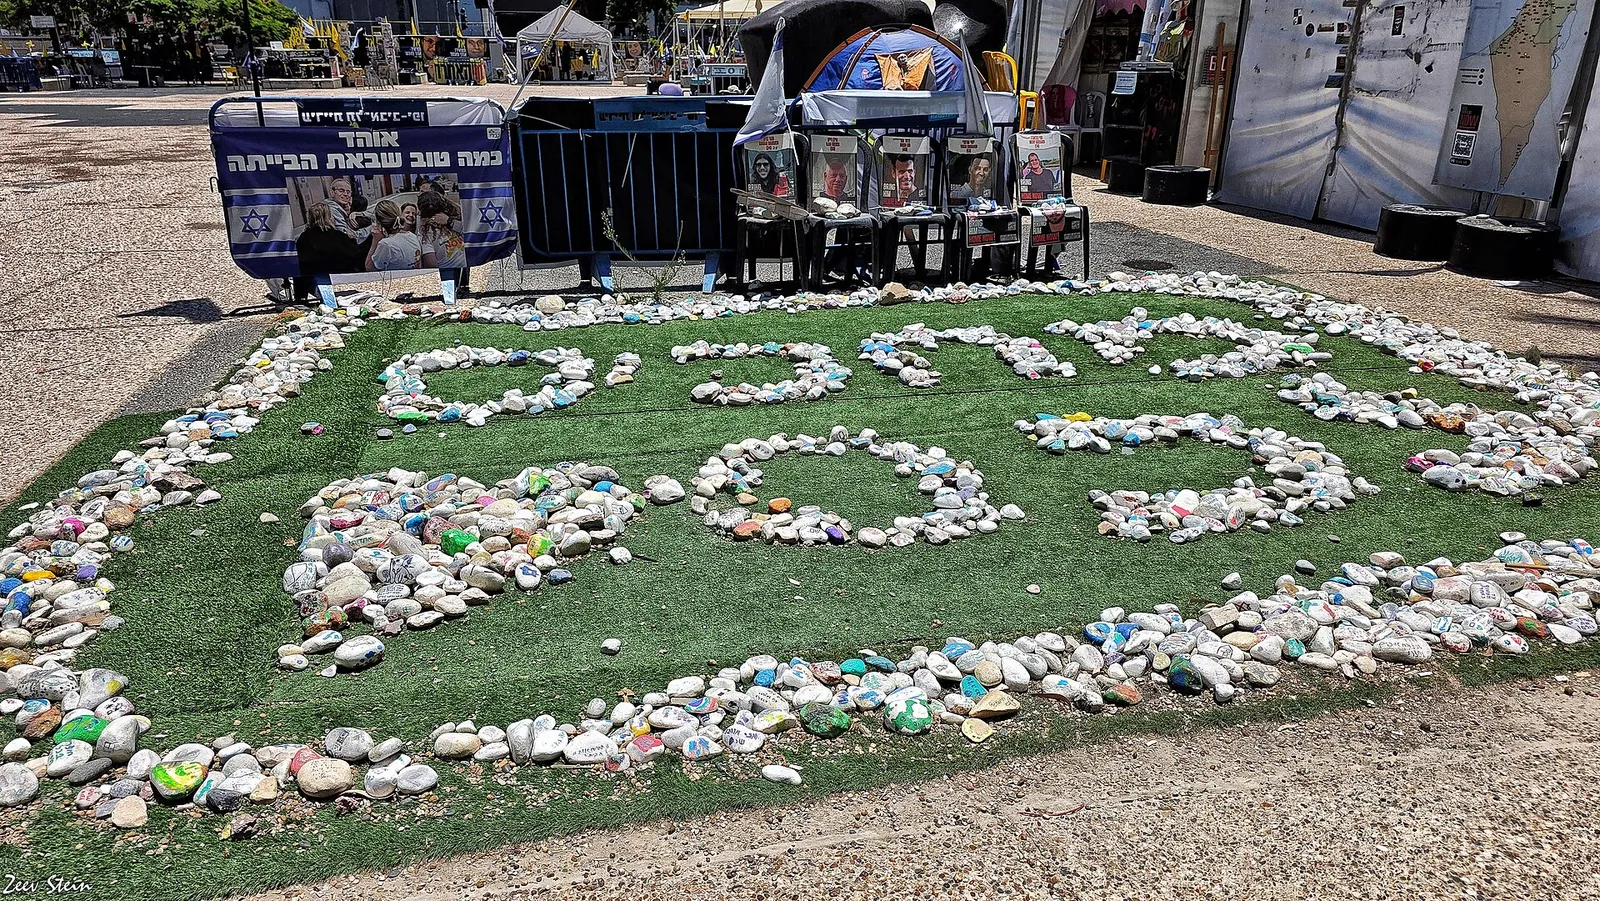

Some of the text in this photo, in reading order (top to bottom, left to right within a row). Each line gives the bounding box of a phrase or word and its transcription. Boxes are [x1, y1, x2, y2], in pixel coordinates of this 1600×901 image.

[1459, 114, 1479, 127] NOW
[338, 130, 400, 148] אוהד
[227, 149, 503, 172] כמה טוב שבאת הבייתה
[969, 234, 982, 243] HOME
[982, 232, 996, 242] NOW!
[1033, 234, 1046, 242] HOME
[1046, 232, 1060, 242] NOW!
